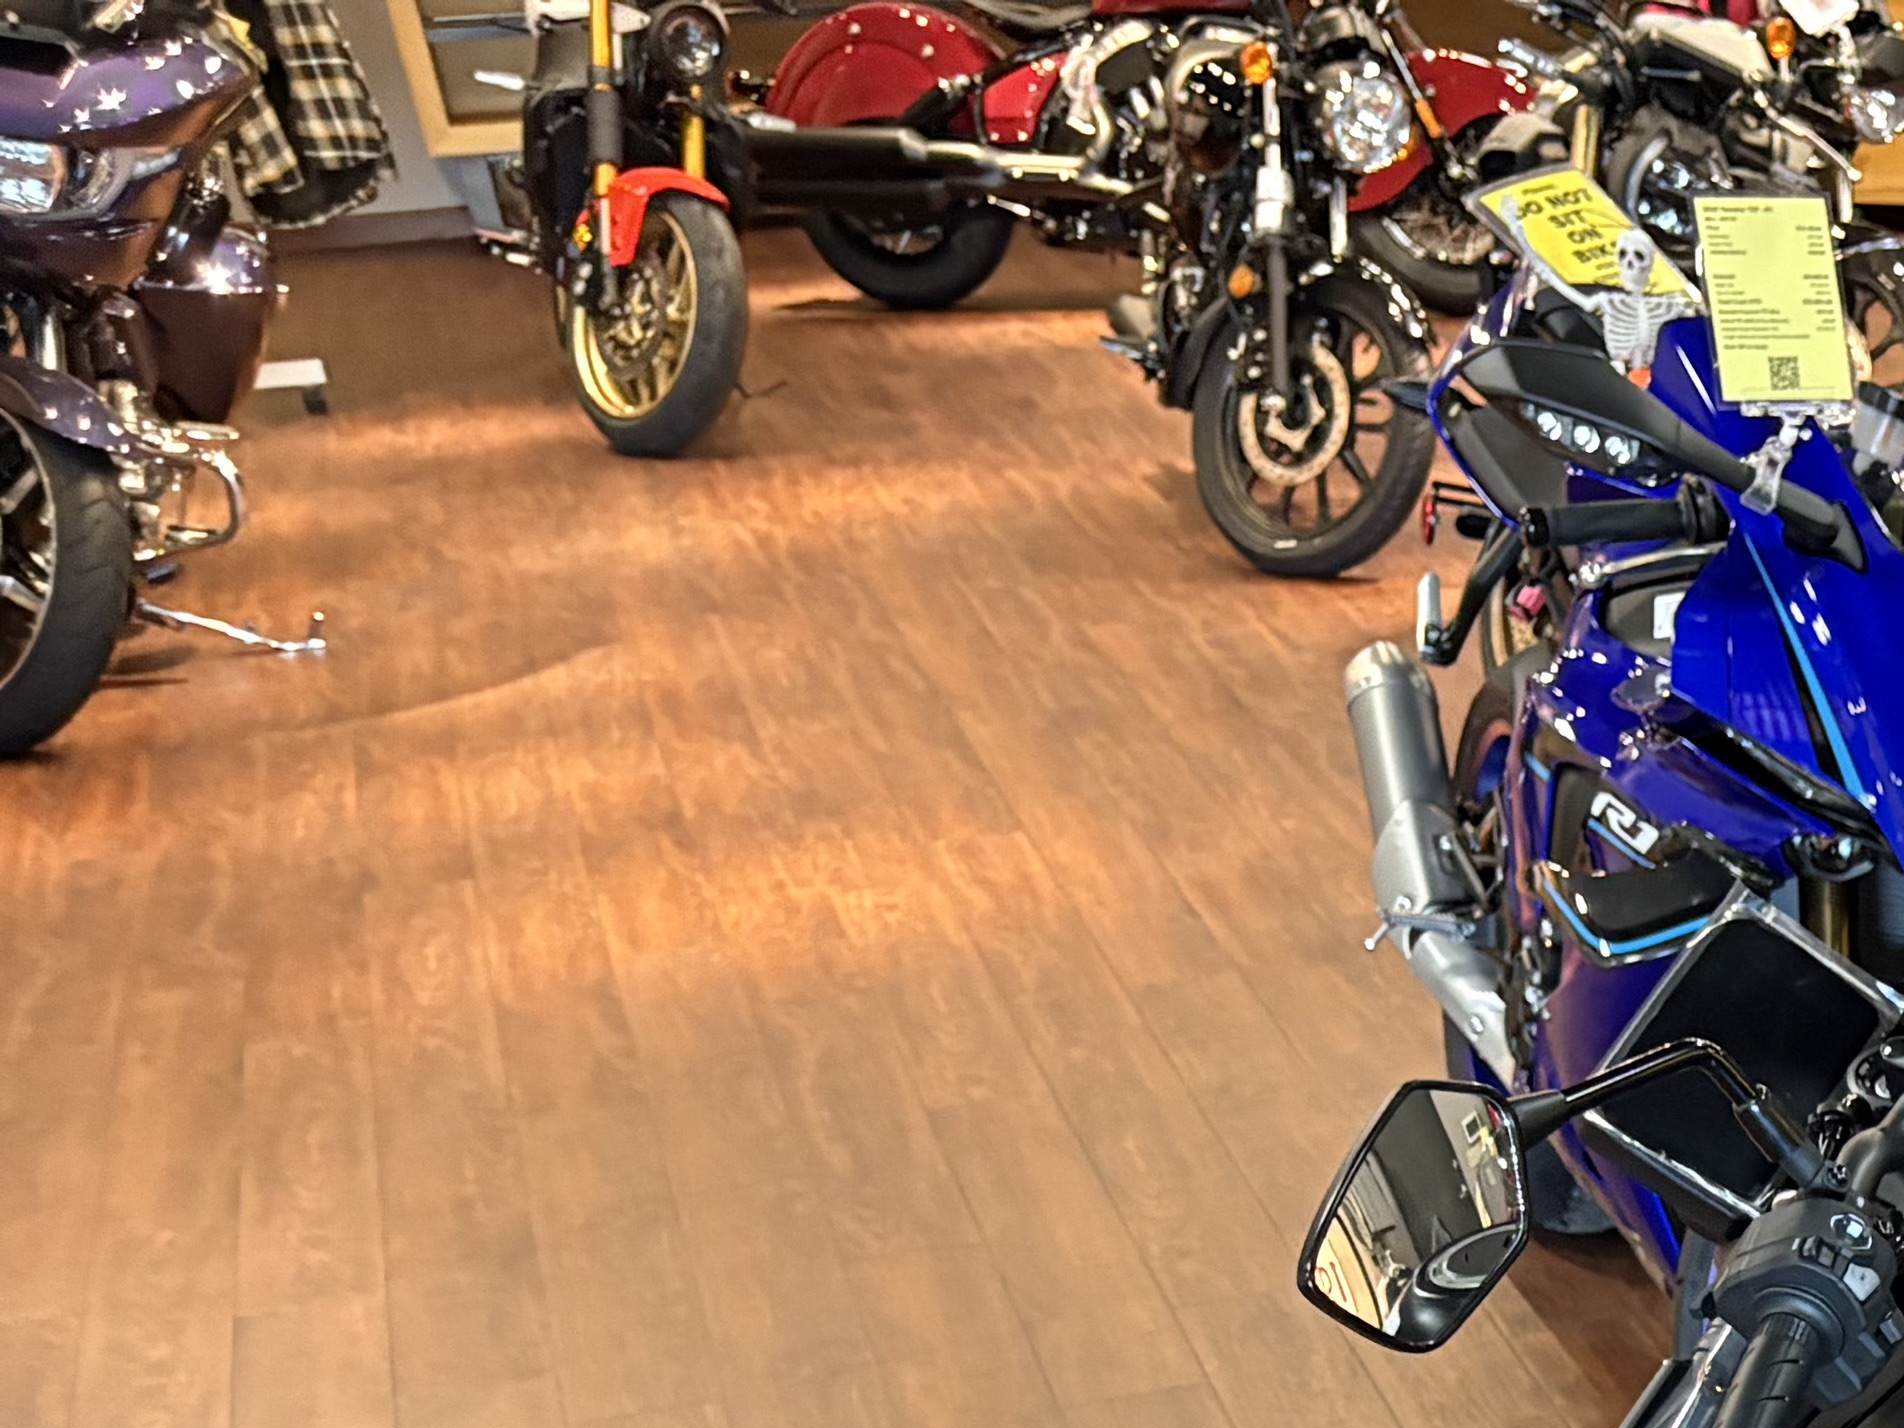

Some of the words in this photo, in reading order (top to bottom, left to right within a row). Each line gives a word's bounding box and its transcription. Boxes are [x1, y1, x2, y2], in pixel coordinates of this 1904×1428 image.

[1545, 188, 1593, 209] NOT
[1548, 209, 1587, 228] SIT
[1567, 226, 1604, 245] ON
